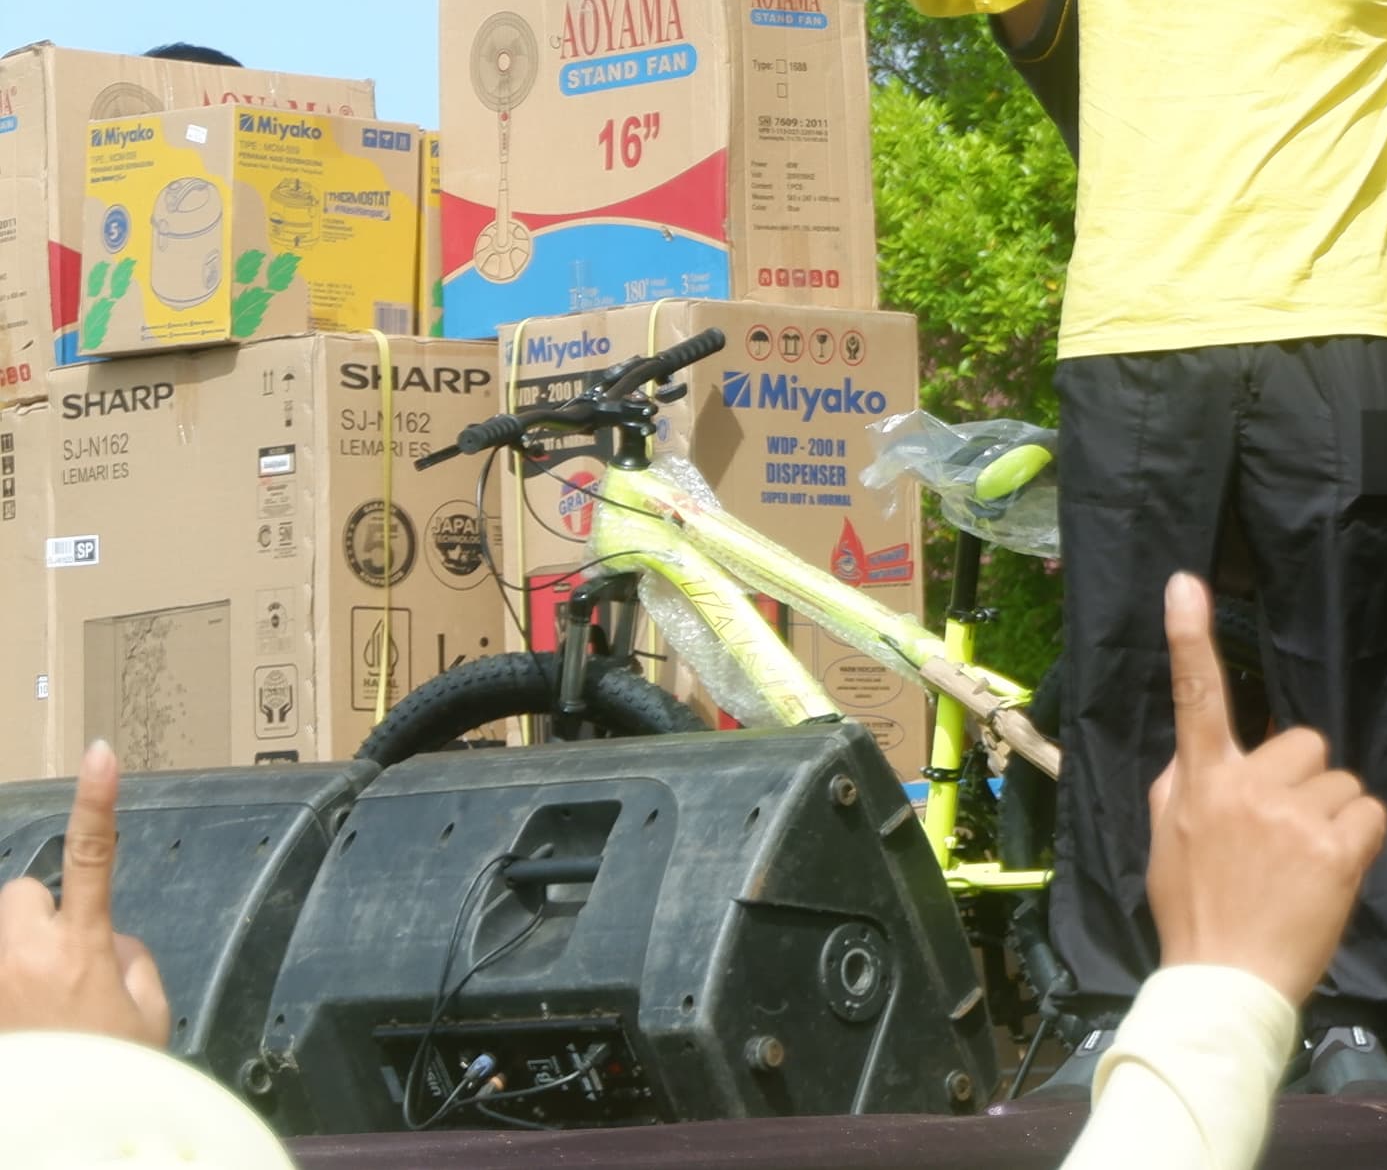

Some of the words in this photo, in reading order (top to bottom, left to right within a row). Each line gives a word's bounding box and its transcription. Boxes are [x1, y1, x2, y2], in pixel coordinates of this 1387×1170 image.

[754, 12, 794, 24] STAND
[798, 16, 823, 26] FAN
[567, 60, 639, 89] STAND
[646, 51, 688, 76] FAN
[257, 116, 322, 140] Miyako
[806, 117, 828, 127] 2011
[104, 124, 154, 148] Miyako
[527, 330, 611, 368] Miyako
[62, 382, 174, 421] SHARP
[547, 381, 572, 403] 200
[758, 373, 886, 422] Miyako
[63, 433, 129, 462] SJ-N162
[766, 436, 798, 455] WDP
[808, 438, 833, 457] 200
[837, 439, 846, 458] H
[62, 464, 109, 486] LEMARI
[112, 462, 129, 480] ES
[766, 462, 846, 487] DISPENSER
[76, 541, 94, 560] SP
